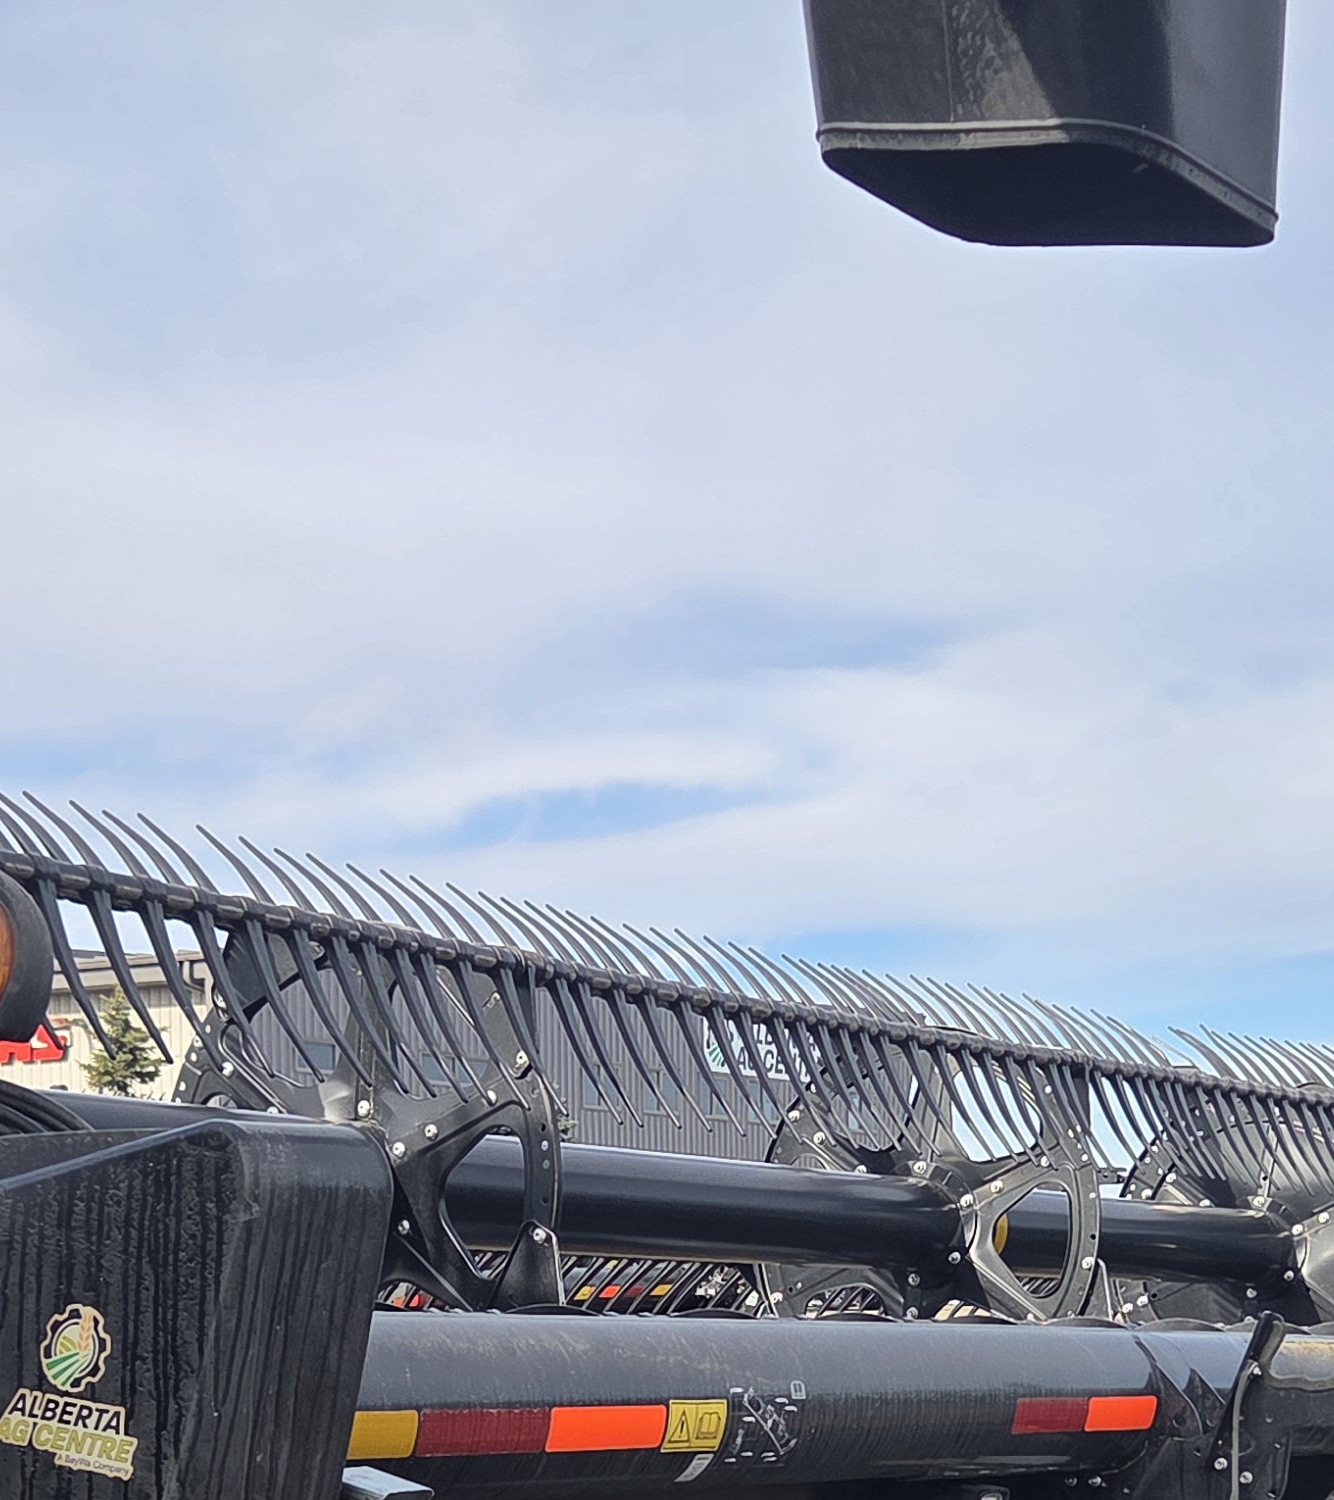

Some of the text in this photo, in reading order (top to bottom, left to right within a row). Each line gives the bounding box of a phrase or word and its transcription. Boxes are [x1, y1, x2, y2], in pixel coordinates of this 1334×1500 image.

[8, 1392, 121, 1435] ALBERTA
[34, 1423, 134, 1464] CENTRE
[93, 1459, 131, 1477] Company
